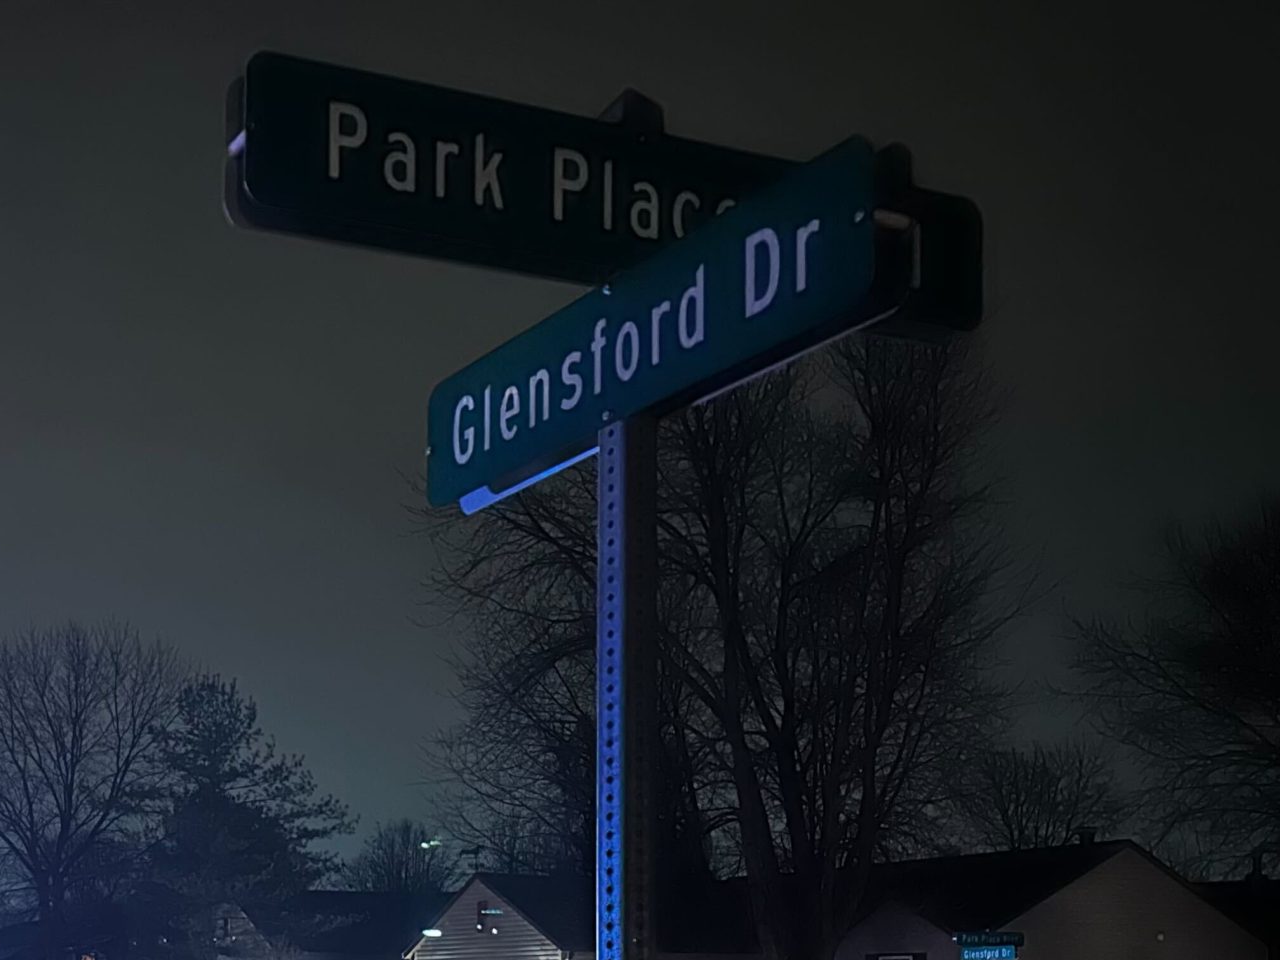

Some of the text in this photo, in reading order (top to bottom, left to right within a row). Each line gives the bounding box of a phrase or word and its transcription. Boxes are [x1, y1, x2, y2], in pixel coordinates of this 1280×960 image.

[326, 100, 737, 242] Park Plac
[451, 216, 822, 466] Glensford Dr
[963, 948, 1011, 959] Glensford Dr
